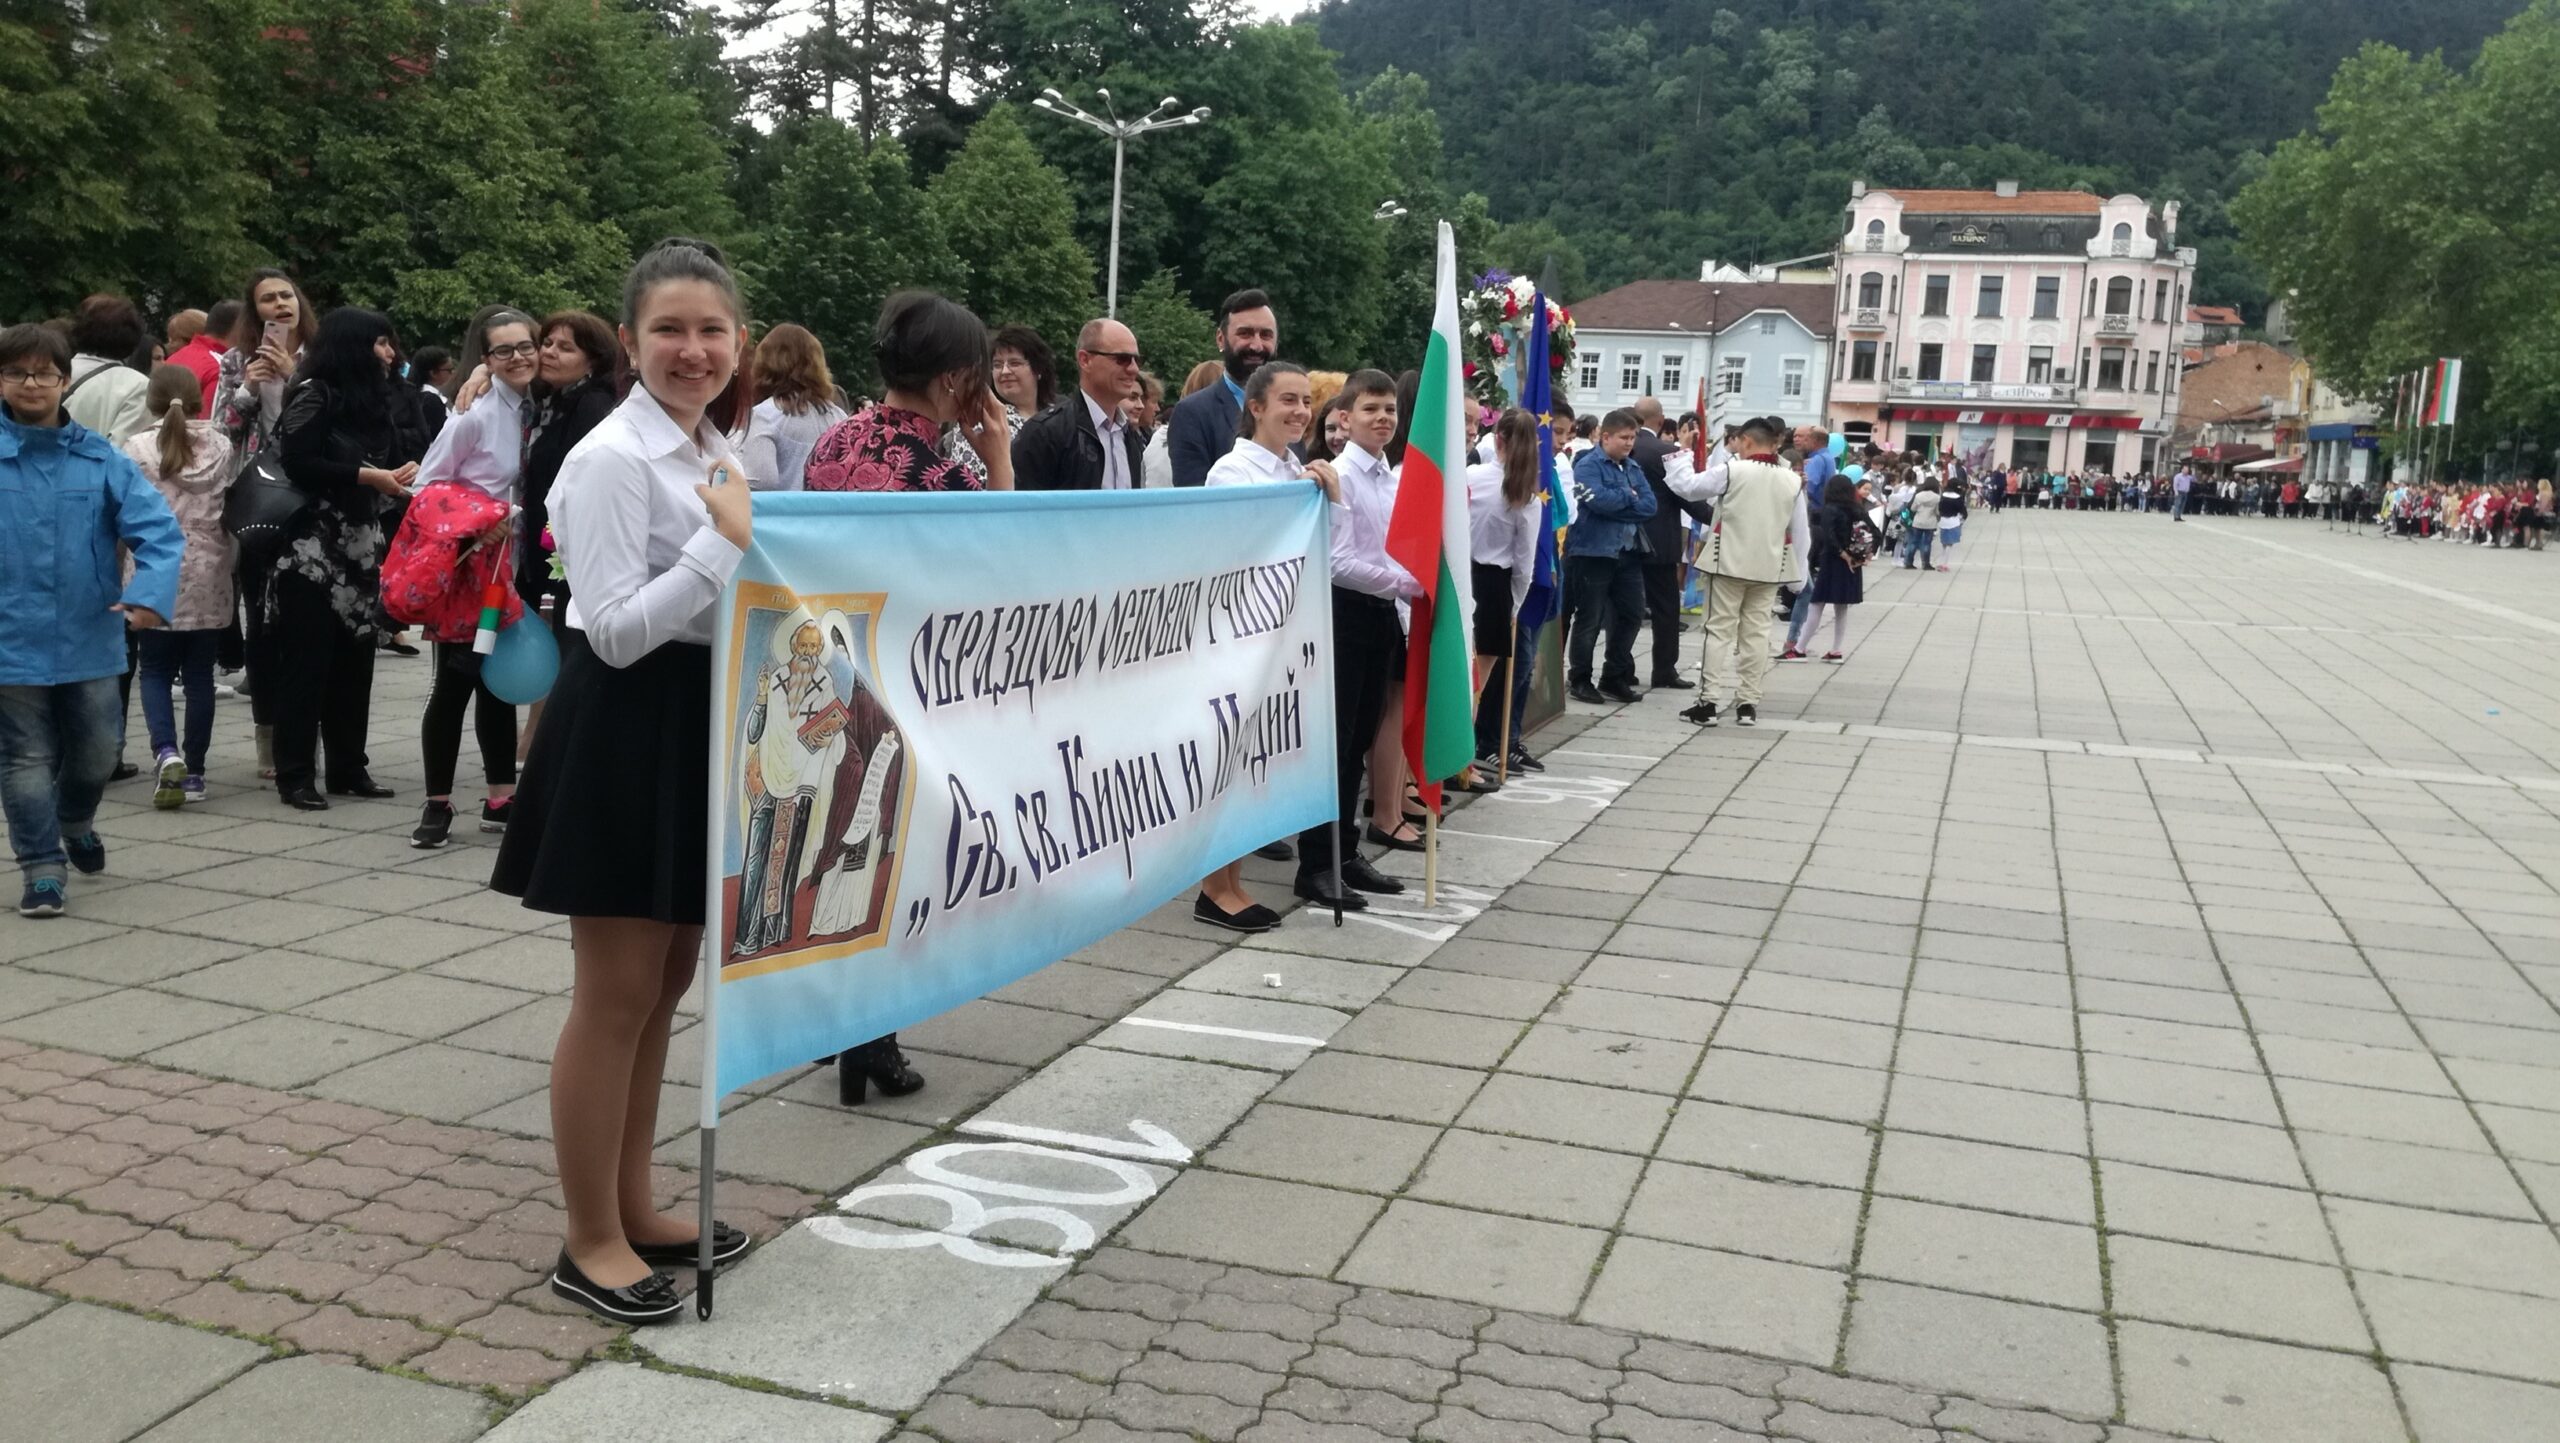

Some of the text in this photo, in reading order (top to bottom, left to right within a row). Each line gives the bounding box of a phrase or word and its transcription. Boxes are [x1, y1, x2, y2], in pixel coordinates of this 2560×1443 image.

[910, 556, 1306, 714] ОБРАЗЦОВО ОСНОВНО УЧИЛИ
[1057, 735, 1177, 880] Кирил
[1178, 740, 1203, 813] и
[803, 1118, 1194, 1268] 108
